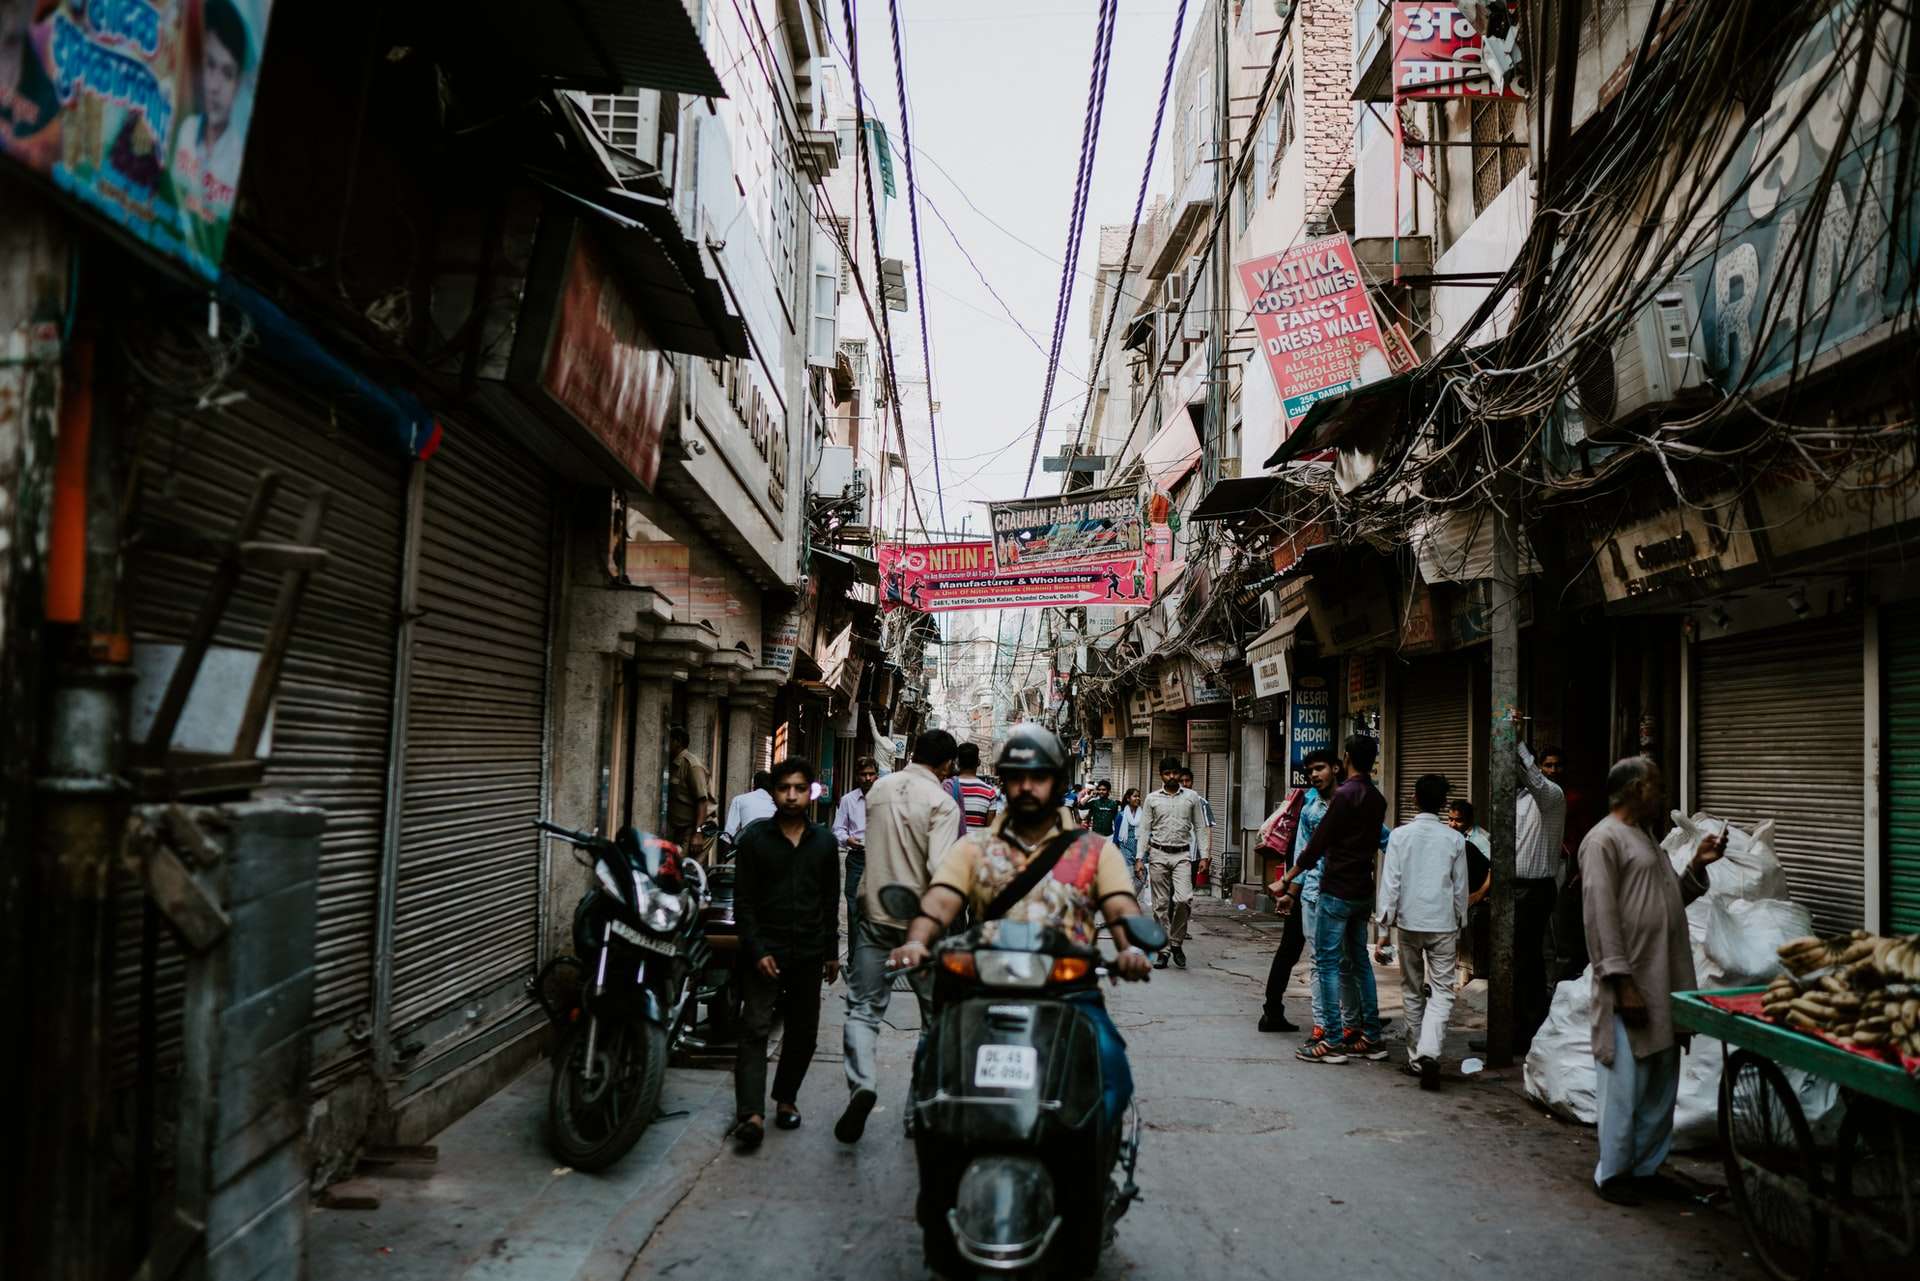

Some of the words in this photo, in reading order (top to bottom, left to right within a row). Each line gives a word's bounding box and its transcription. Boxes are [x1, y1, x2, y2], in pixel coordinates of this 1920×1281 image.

[1252, 250, 1345, 292] VATIKA
[1253, 268, 1359, 314] COSTUMES
[1275, 295, 1349, 331] FANCY
[1267, 324, 1323, 356] DRESS
[1323, 312, 1373, 338] WALE
[1292, 343, 1333, 361] DEALS
[1335, 338, 1350, 351] IN
[1284, 360, 1308, 375] ALL
[1309, 349, 1352, 369] TYPES
[1284, 376, 1326, 397] FANCY
[1318, 384, 1349, 399] DARIBA
[994, 509, 1050, 531] CHAUHAN
[1051, 503, 1087, 526] FANCY
[1088, 497, 1137, 519] DRESSES
[928, 547, 979, 571] NITIN
[939, 577, 1015, 590] Manufacturer
[1018, 577, 1027, 585] &
[1030, 575, 1093, 585] Wholesaler
[961, 598, 977, 606] Floor,
[1015, 594, 1037, 602] Chandni
[1038, 593, 1058, 601] Chowk,
[1296, 690, 1329, 705] KESAR
[1298, 709, 1327, 724] PISTA
[1293, 727, 1331, 742] BADAM
[1293, 770, 1308, 785] Rs.
